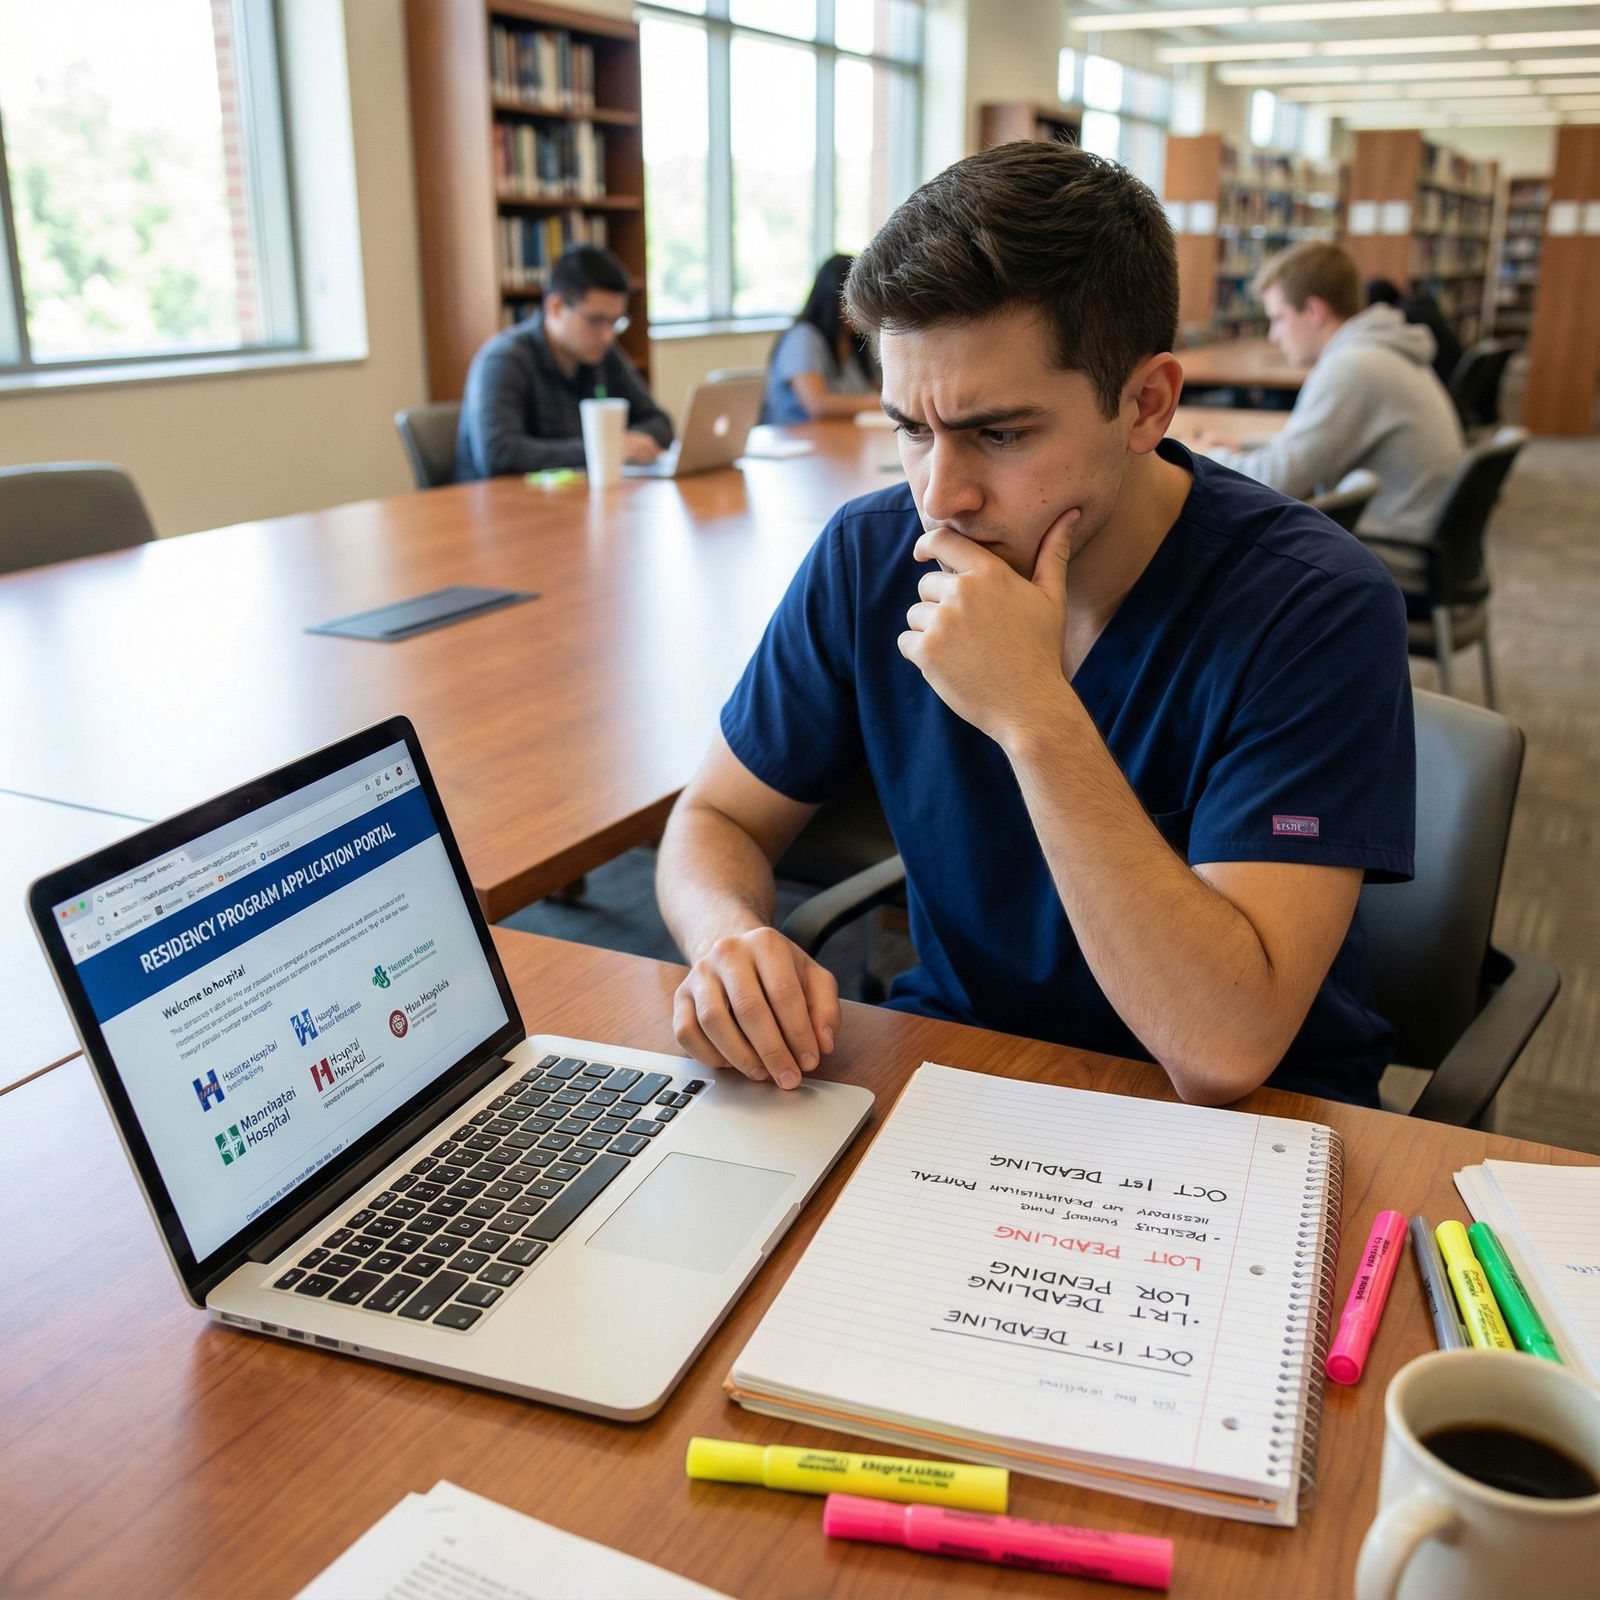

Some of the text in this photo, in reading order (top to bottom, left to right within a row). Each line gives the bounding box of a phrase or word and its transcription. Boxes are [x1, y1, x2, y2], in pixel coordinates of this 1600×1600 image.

[138, 915, 219, 975] RESIDENCY
[215, 882, 281, 932] PROGRAM
[277, 842, 356, 898] APPLICATION
[352, 819, 396, 857] PORTAL
[160, 987, 203, 1021] Welcome
[244, 1106, 292, 1151] Hospital
[989, 1155, 1102, 1184] DEADLING
[1173, 1184, 1228, 1202] OCT
[968, 1275, 1103, 1314] DEADLING
[989, 1261, 1190, 1306] LOR PENDING
[943, 1309, 1068, 1345] DEADLINE
[1139, 1345, 1193, 1367] OCT
